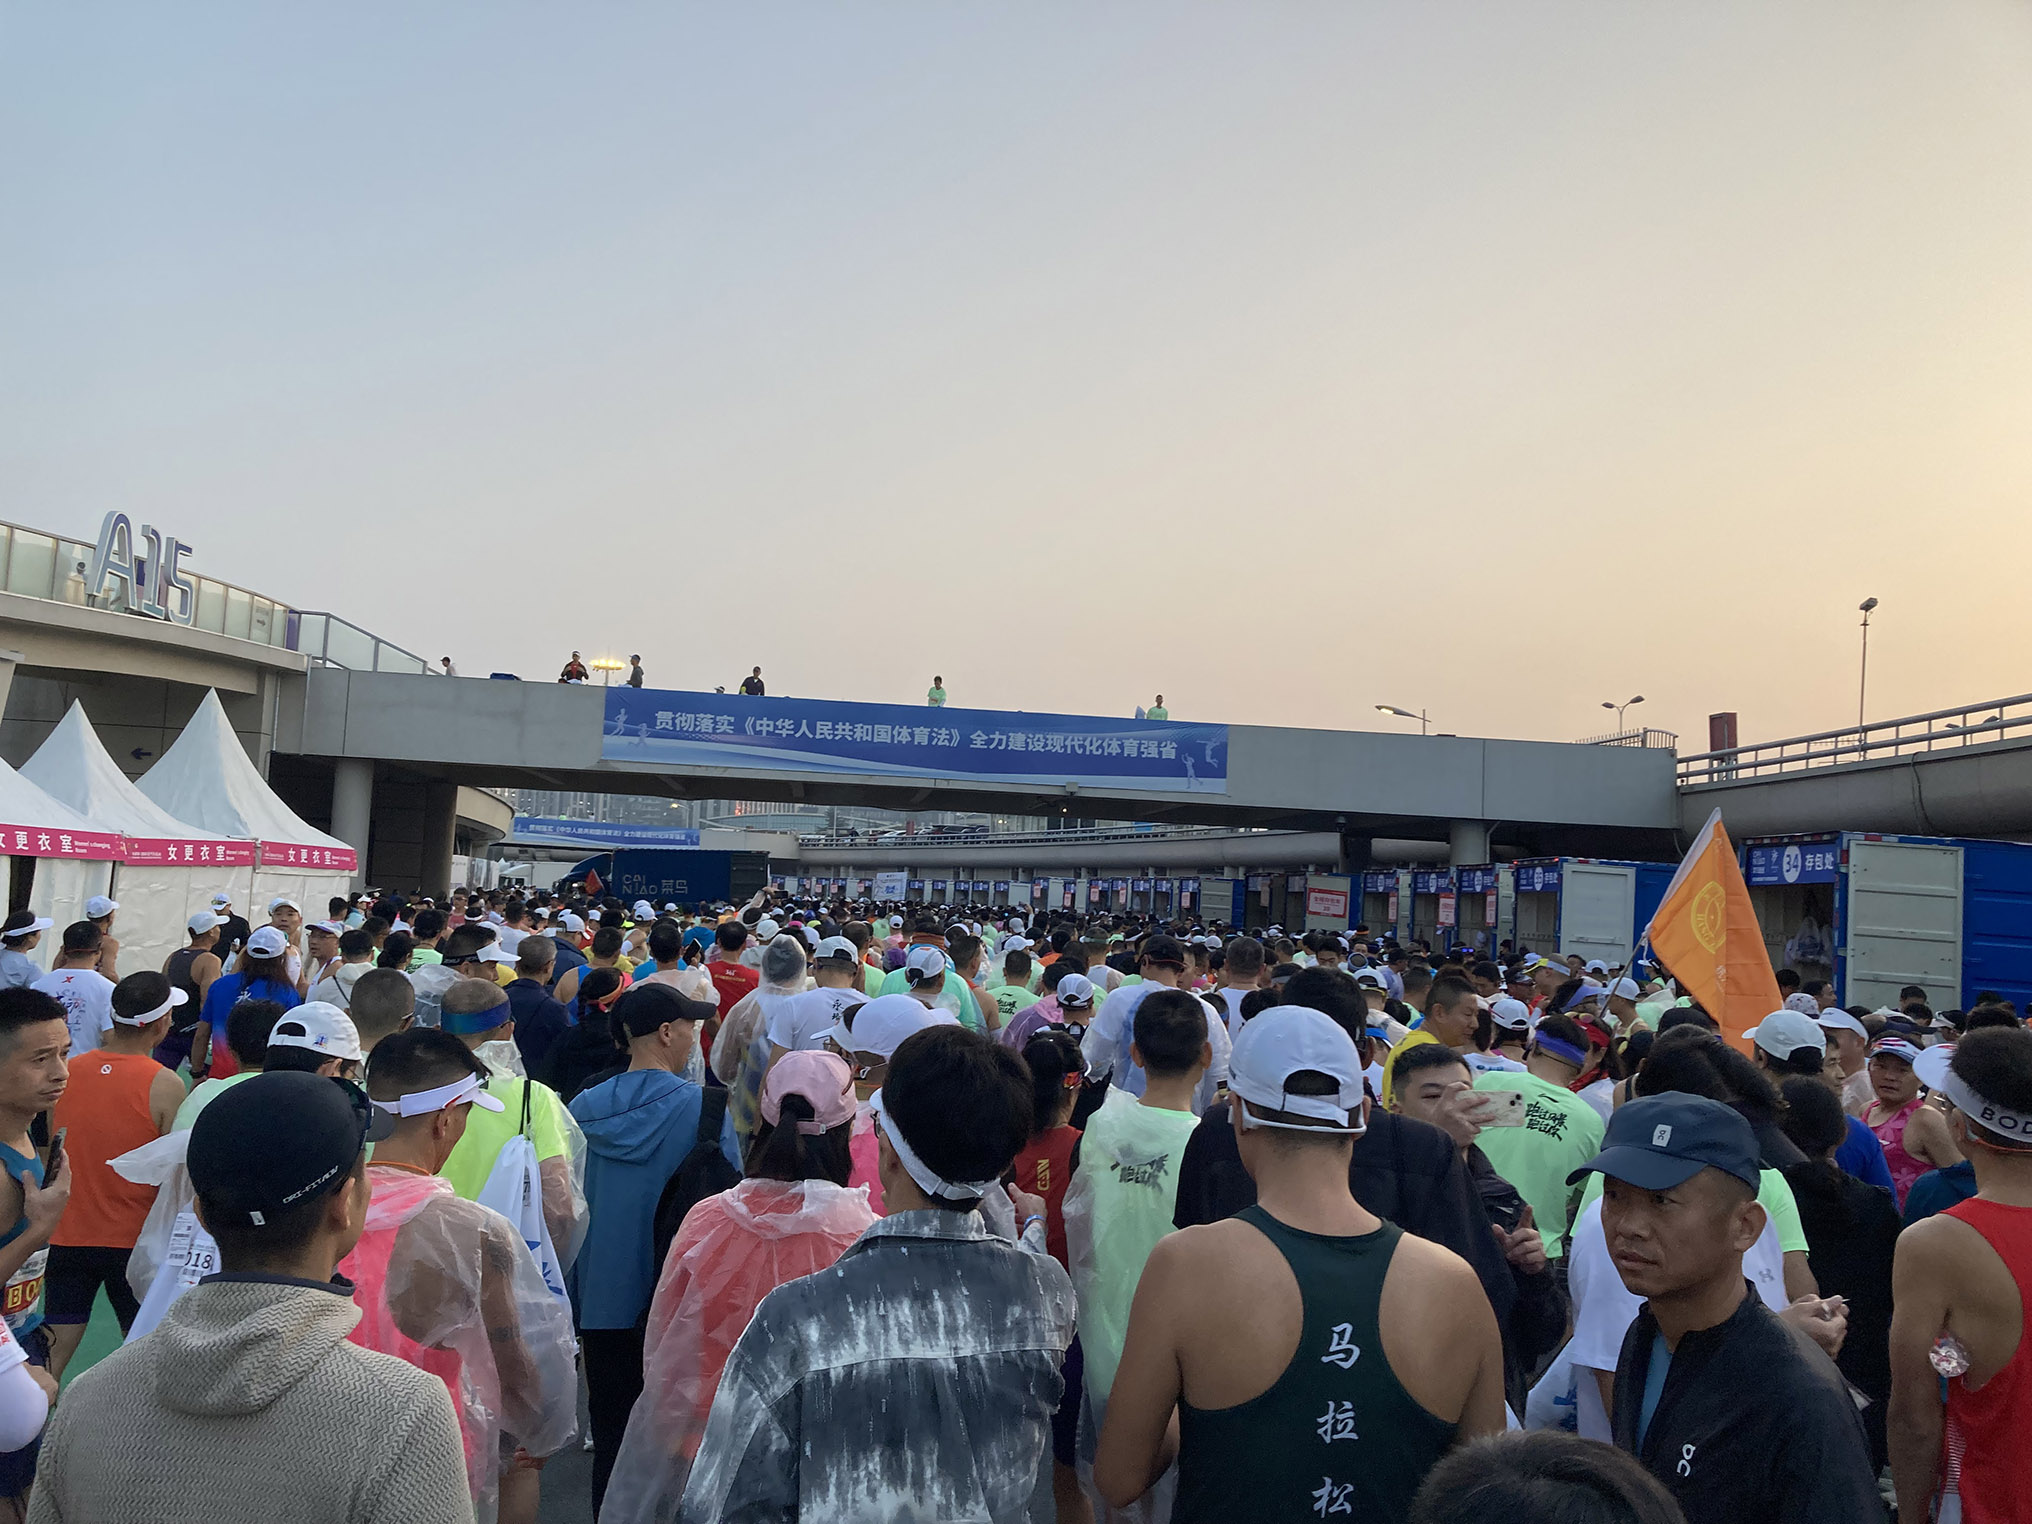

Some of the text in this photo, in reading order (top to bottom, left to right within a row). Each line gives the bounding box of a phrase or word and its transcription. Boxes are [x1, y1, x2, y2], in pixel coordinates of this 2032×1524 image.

[88, 511, 194, 626] A15
[655, 711, 1178, 760] 贯彻落实《中华人民共和国体育法》全力建设现代化体育强省
[167, 843, 226, 861] 女更衣室
[288, 847, 332, 865] 女更衣室
[1785, 853, 1800, 873] 34
[1805, 852, 1834, 871] 存包处
[622, 874, 646, 885] CAI
[661, 879, 688, 895] 菜鸟
[1311, 1322, 1361, 1519] 马拉松
